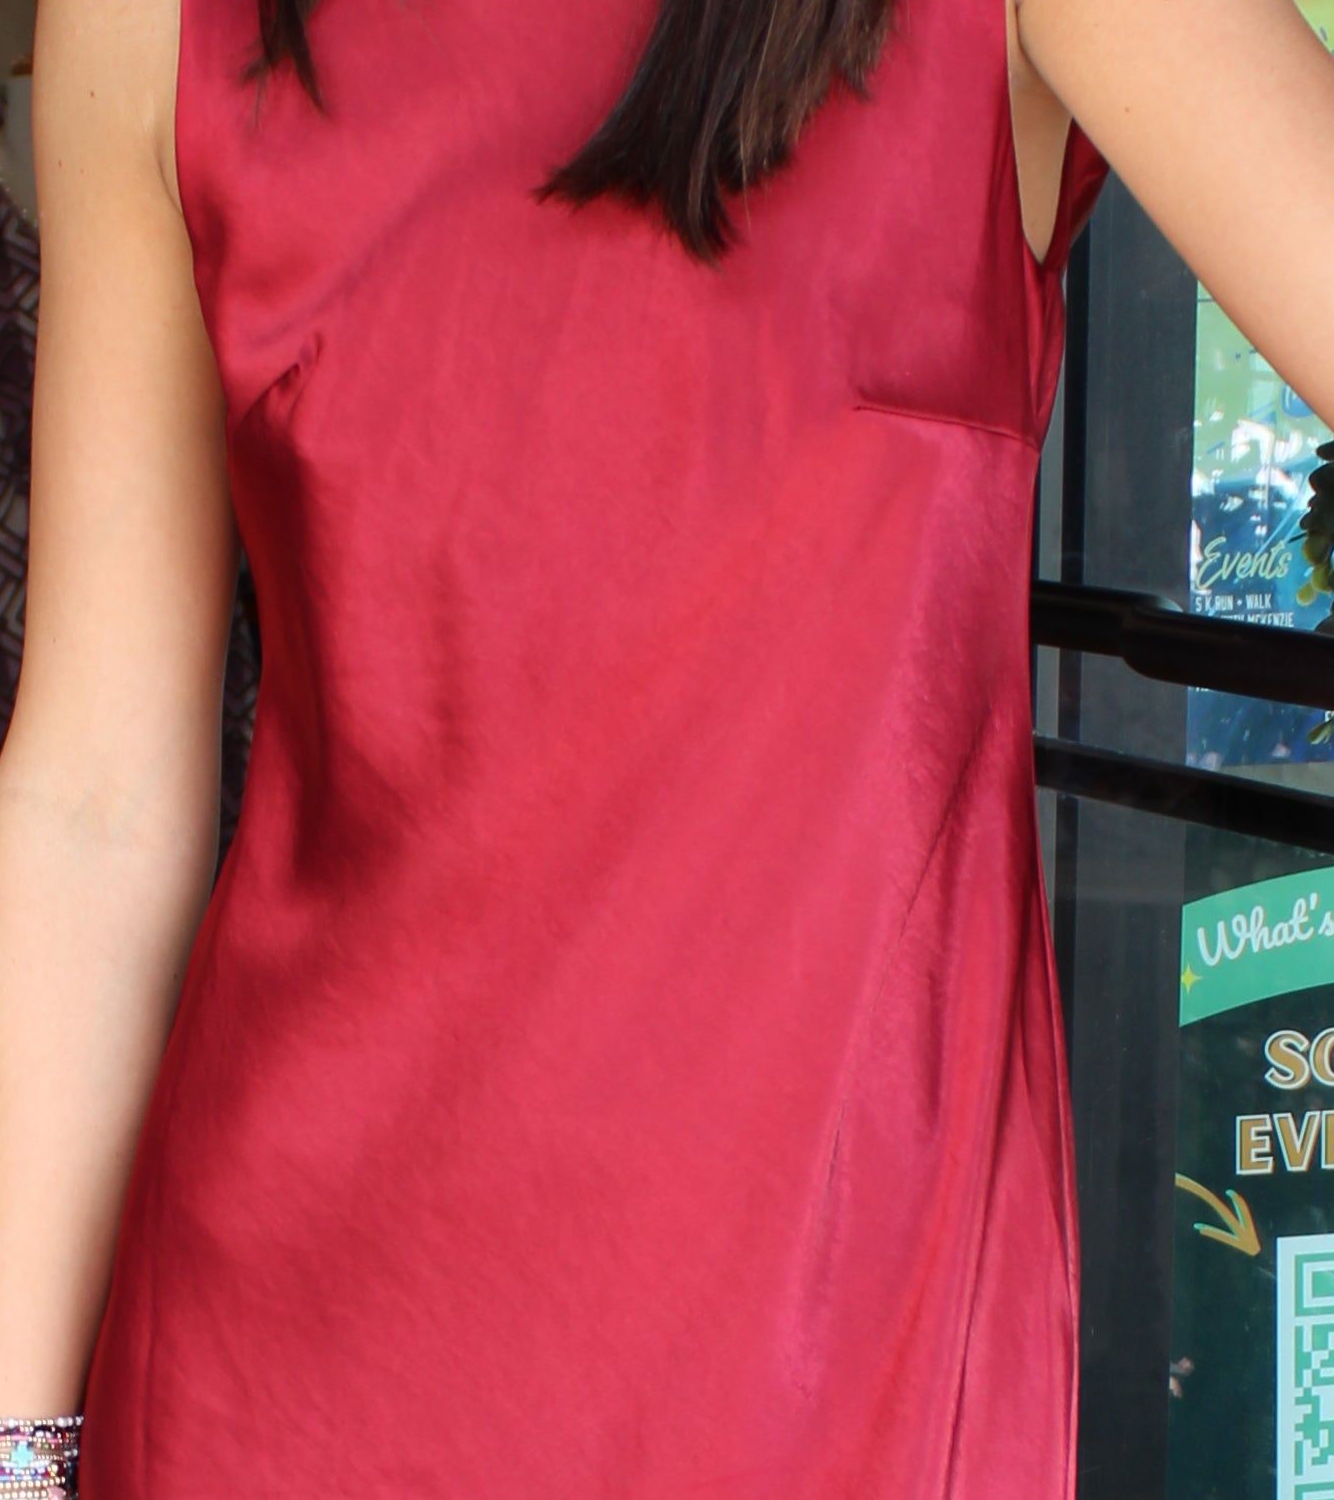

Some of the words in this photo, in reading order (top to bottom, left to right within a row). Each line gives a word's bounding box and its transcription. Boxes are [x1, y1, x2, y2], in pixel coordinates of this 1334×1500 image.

[1196, 536, 1292, 590] Events
[1215, 595, 1234, 611] RUN
[1245, 594, 1272, 609] WALK
